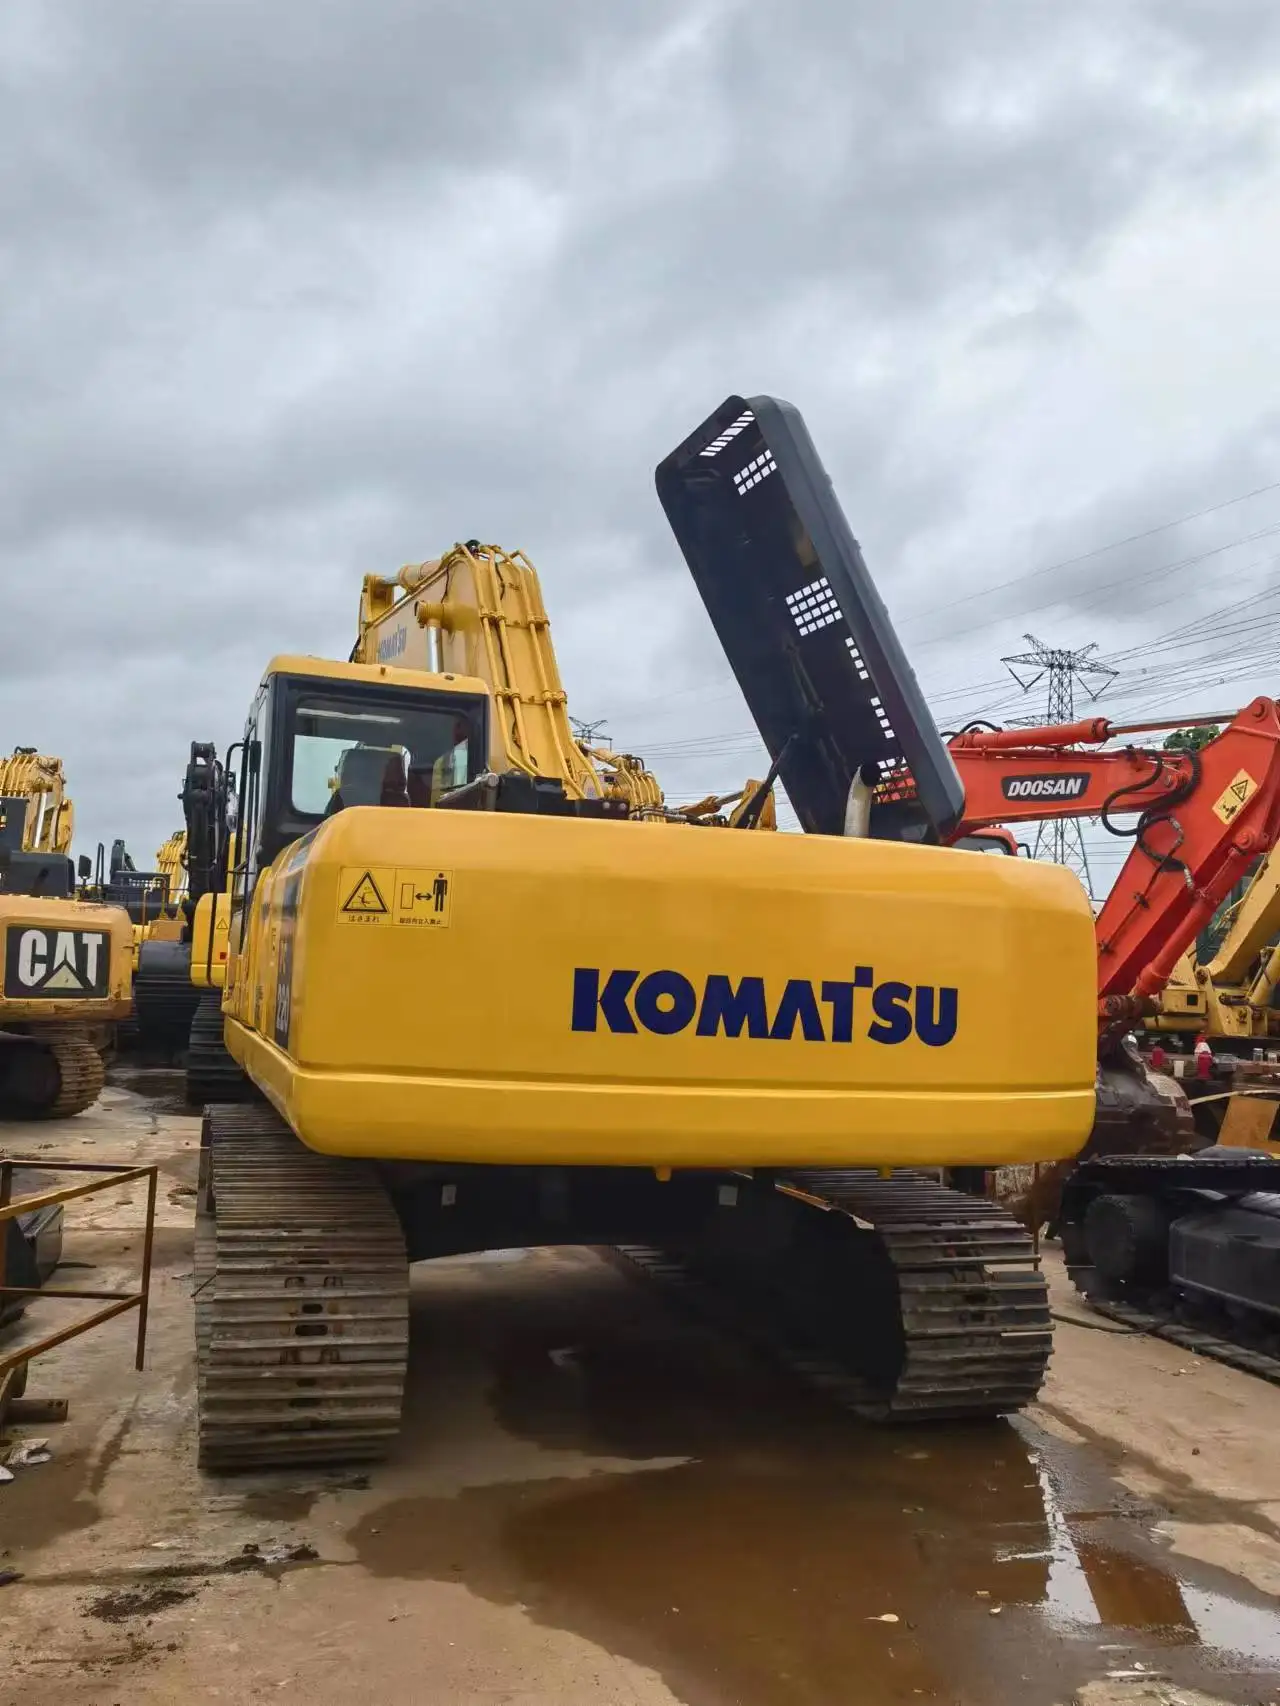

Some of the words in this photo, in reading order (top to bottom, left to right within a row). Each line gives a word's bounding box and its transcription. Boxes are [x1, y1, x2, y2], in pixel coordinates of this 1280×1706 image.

[1007, 777, 1083, 797] DOOSAN
[18, 929, 103, 989] CAT
[572, 966, 958, 1047] KOMATSU
